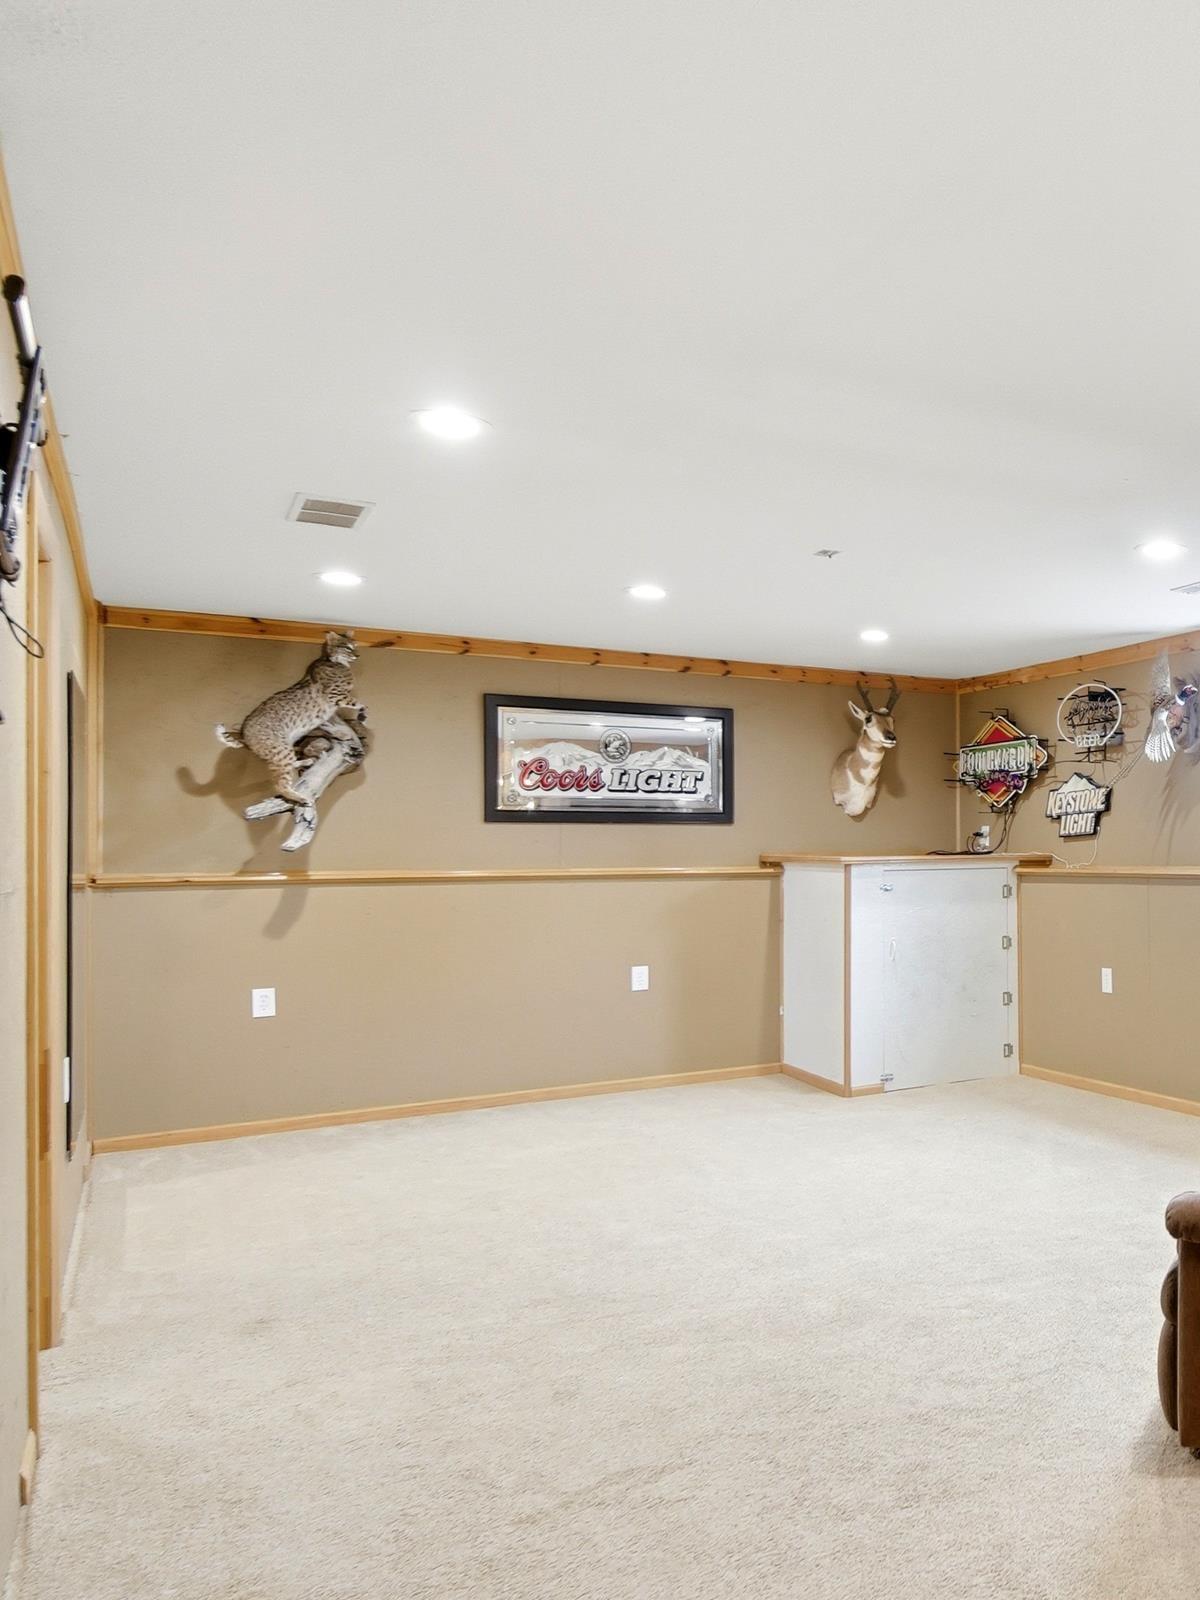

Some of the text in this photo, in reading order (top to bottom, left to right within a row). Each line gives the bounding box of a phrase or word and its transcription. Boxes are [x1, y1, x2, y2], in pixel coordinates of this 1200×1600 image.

[1076, 733, 1104, 748] BEER
[518, 756, 705, 794] Coors LIGHT
[1046, 788, 1107, 818] KEYSTONE
[1060, 812, 1096, 835] LIGHT
